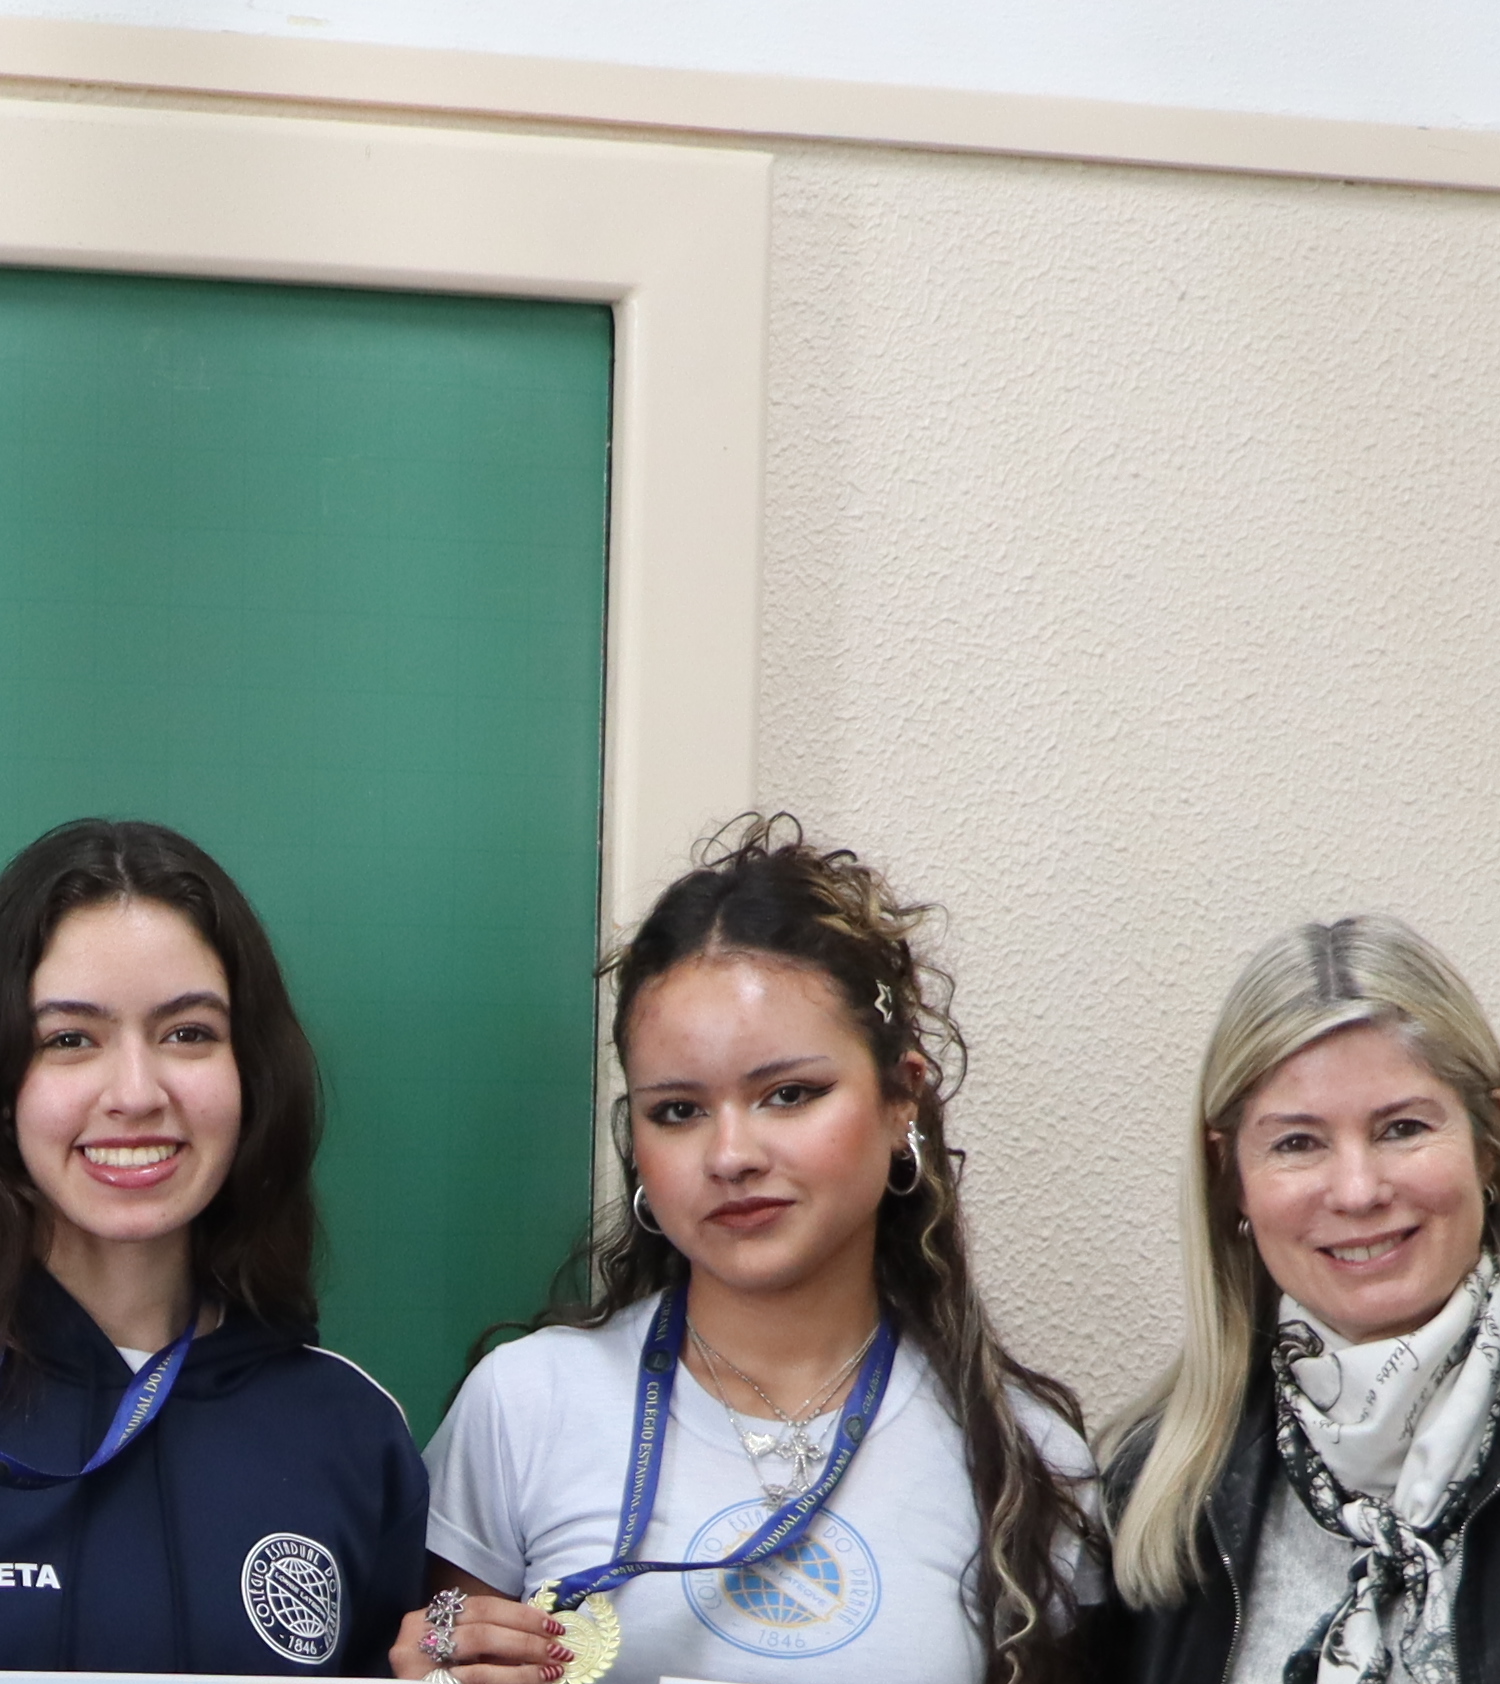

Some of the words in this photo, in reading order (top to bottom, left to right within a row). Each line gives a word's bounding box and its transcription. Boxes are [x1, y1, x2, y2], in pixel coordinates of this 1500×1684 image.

[143, 1373, 162, 1393] DO
[641, 1381, 660, 1441] COLÉGIO
[795, 1494, 818, 1514] DO
[822, 1525, 853, 1553] DO
[248, 1559, 275, 1628] COLÉGIO
[264, 1541, 320, 1566] ESTADUAL
[323, 1566, 337, 1593] DO
[287, 1634, 317, 1655] 1846
[759, 1628, 806, 1648] 1846
